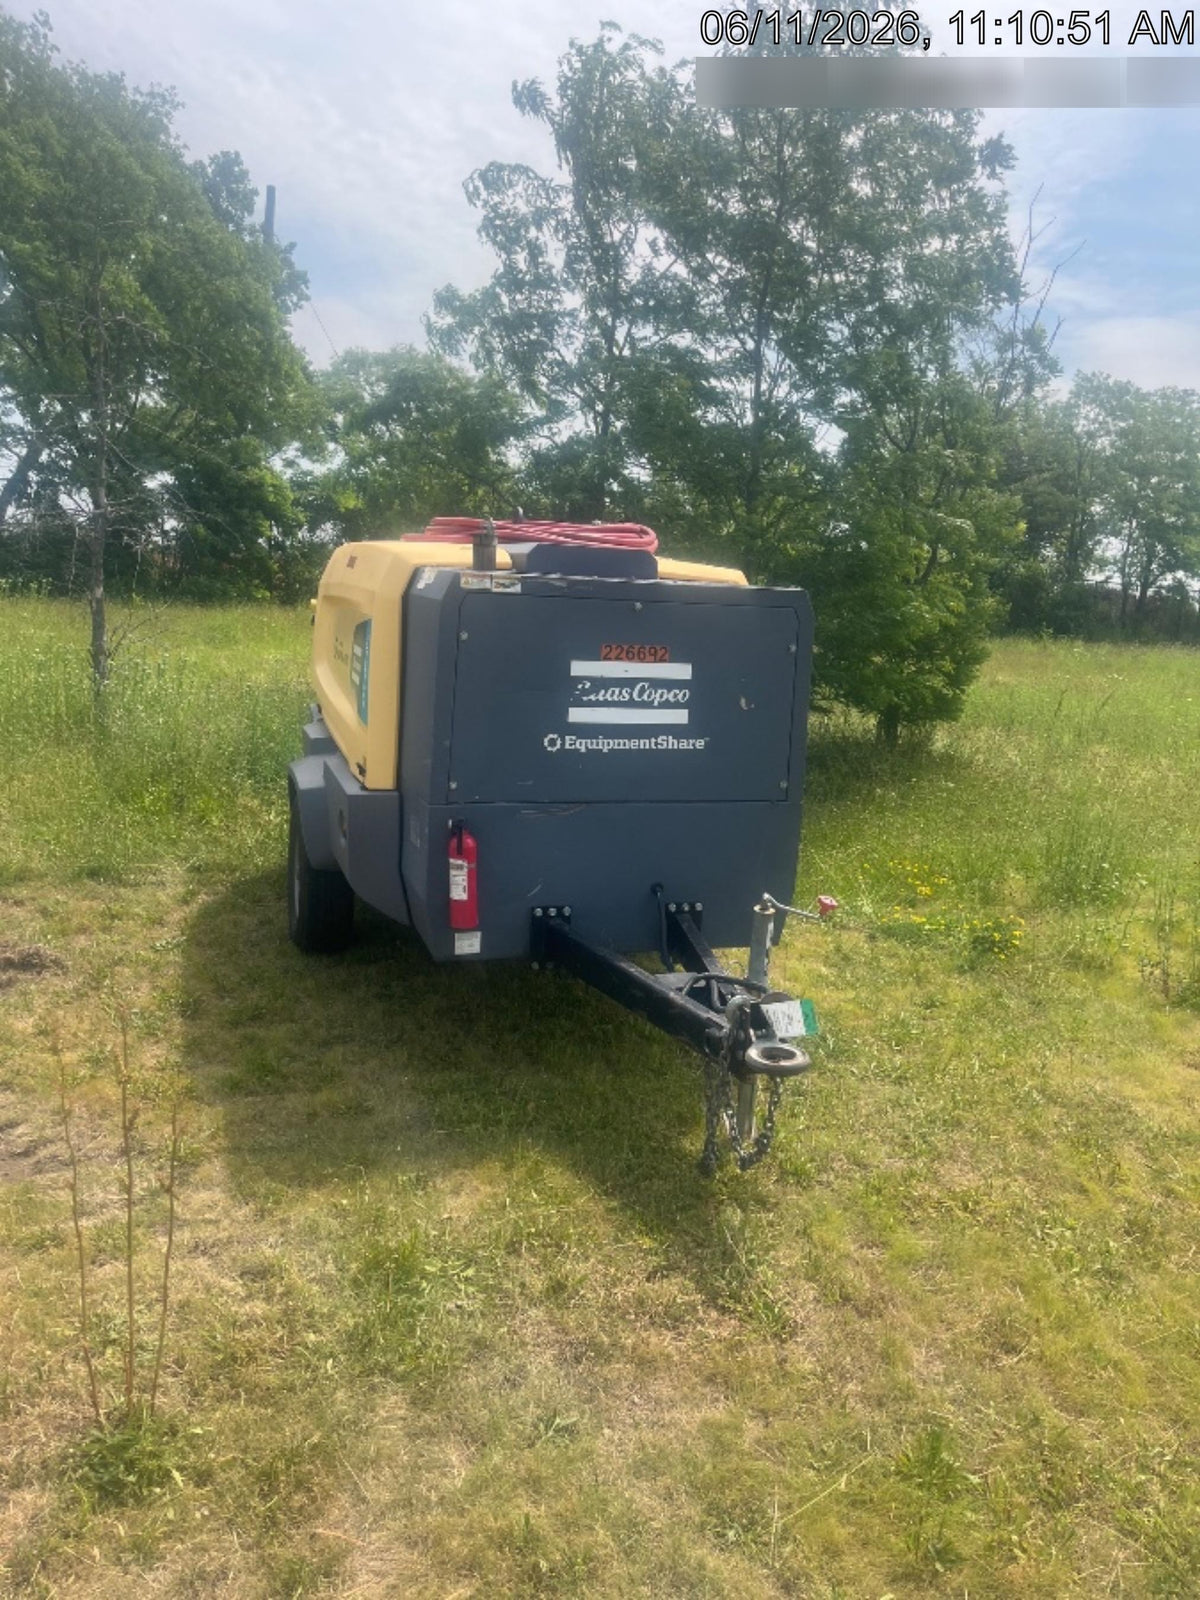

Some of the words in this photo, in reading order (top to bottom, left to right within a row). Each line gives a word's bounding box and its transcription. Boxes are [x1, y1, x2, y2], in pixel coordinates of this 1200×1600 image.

[602, 644, 668, 662] 226692
[632, 682, 690, 706] Copco
[564, 735, 706, 753] EquipmentShare
